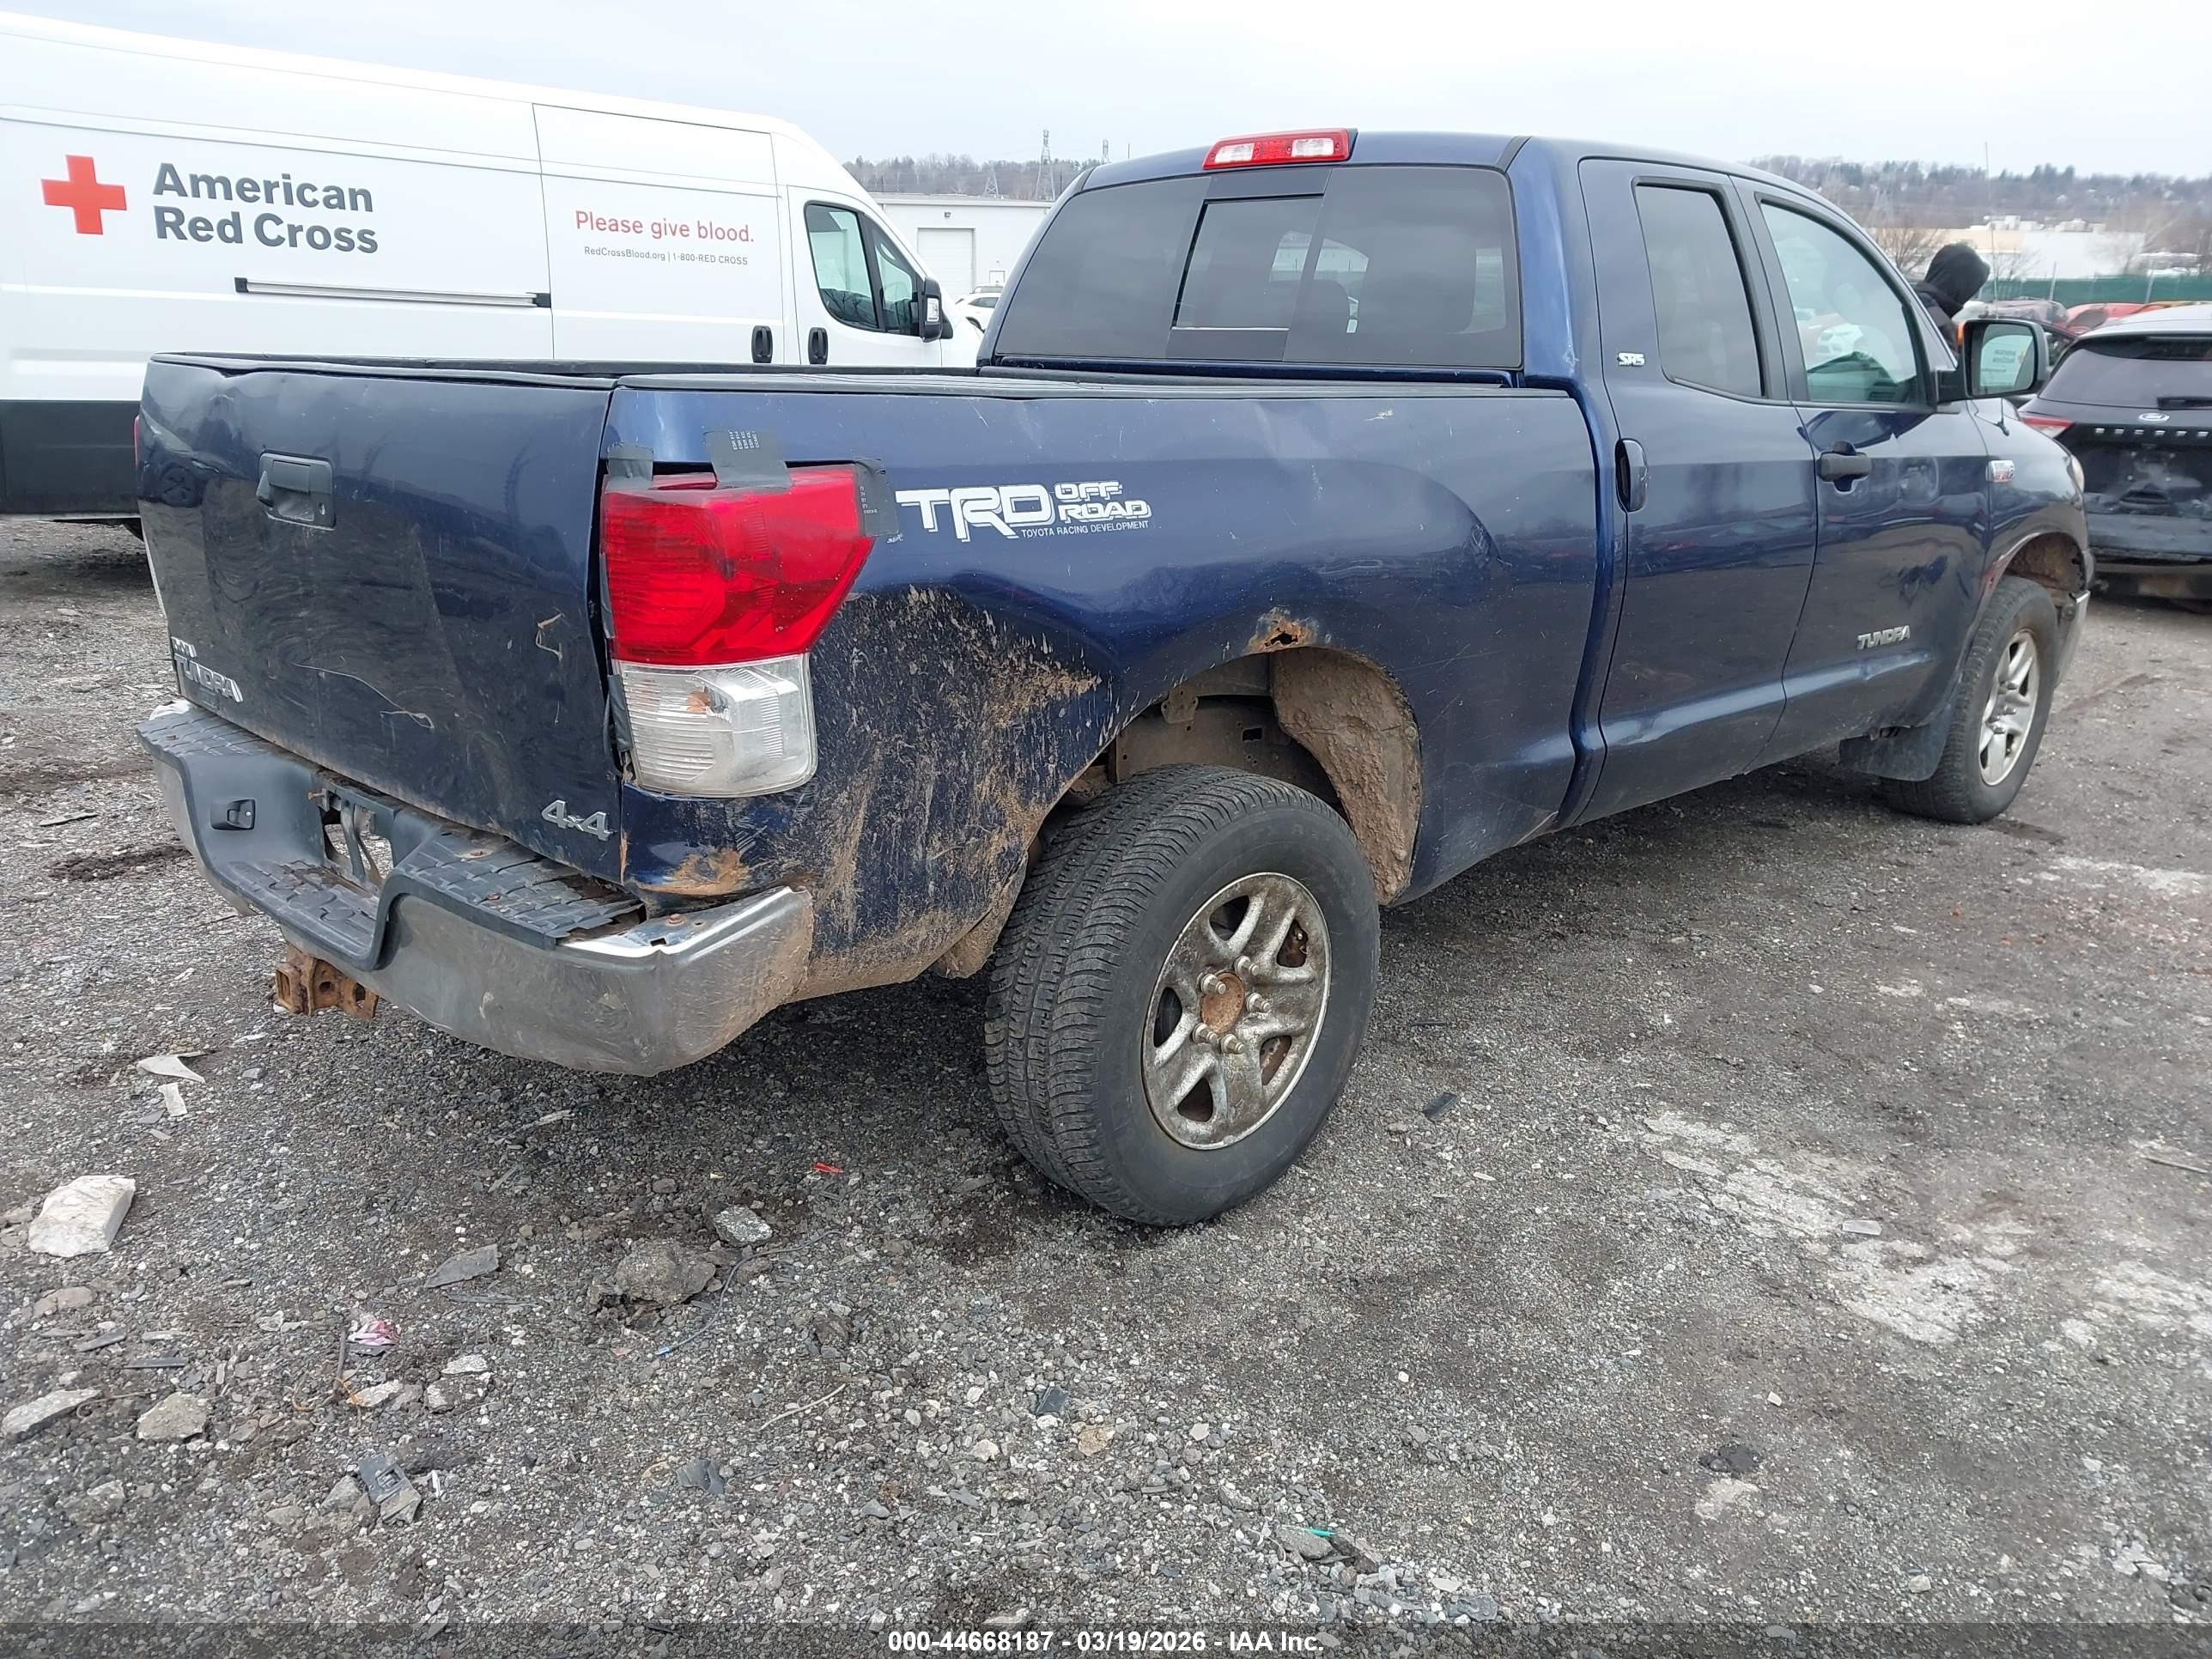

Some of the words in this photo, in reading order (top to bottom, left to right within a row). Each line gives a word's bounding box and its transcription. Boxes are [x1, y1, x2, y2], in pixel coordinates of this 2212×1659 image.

[152, 161, 374, 213] American
[153, 204, 244, 244] Red
[253, 211, 379, 254] Cross
[574, 210, 644, 234] Please
[651, 217, 690, 240] give
[696, 220, 755, 243] blood.
[584, 246, 666, 262] RedCrossBlood.org
[673, 252, 716, 264] 1-800-RED
[718, 255, 749, 266] CROSS
[1618, 352, 1645, 367] SR5
[1054, 481, 1123, 502] OFF
[895, 483, 1056, 543] TRD
[1057, 499, 1152, 524] ROAD
[1020, 527, 1055, 538] TOYOTA
[1056, 525, 1089, 536] RACING
[1091, 520, 1150, 534] DEVELOPMENT
[1857, 624, 1911, 650] TUNDRA
[174, 653, 244, 703] TUNDRA
[541, 799, 614, 842] 4x4
